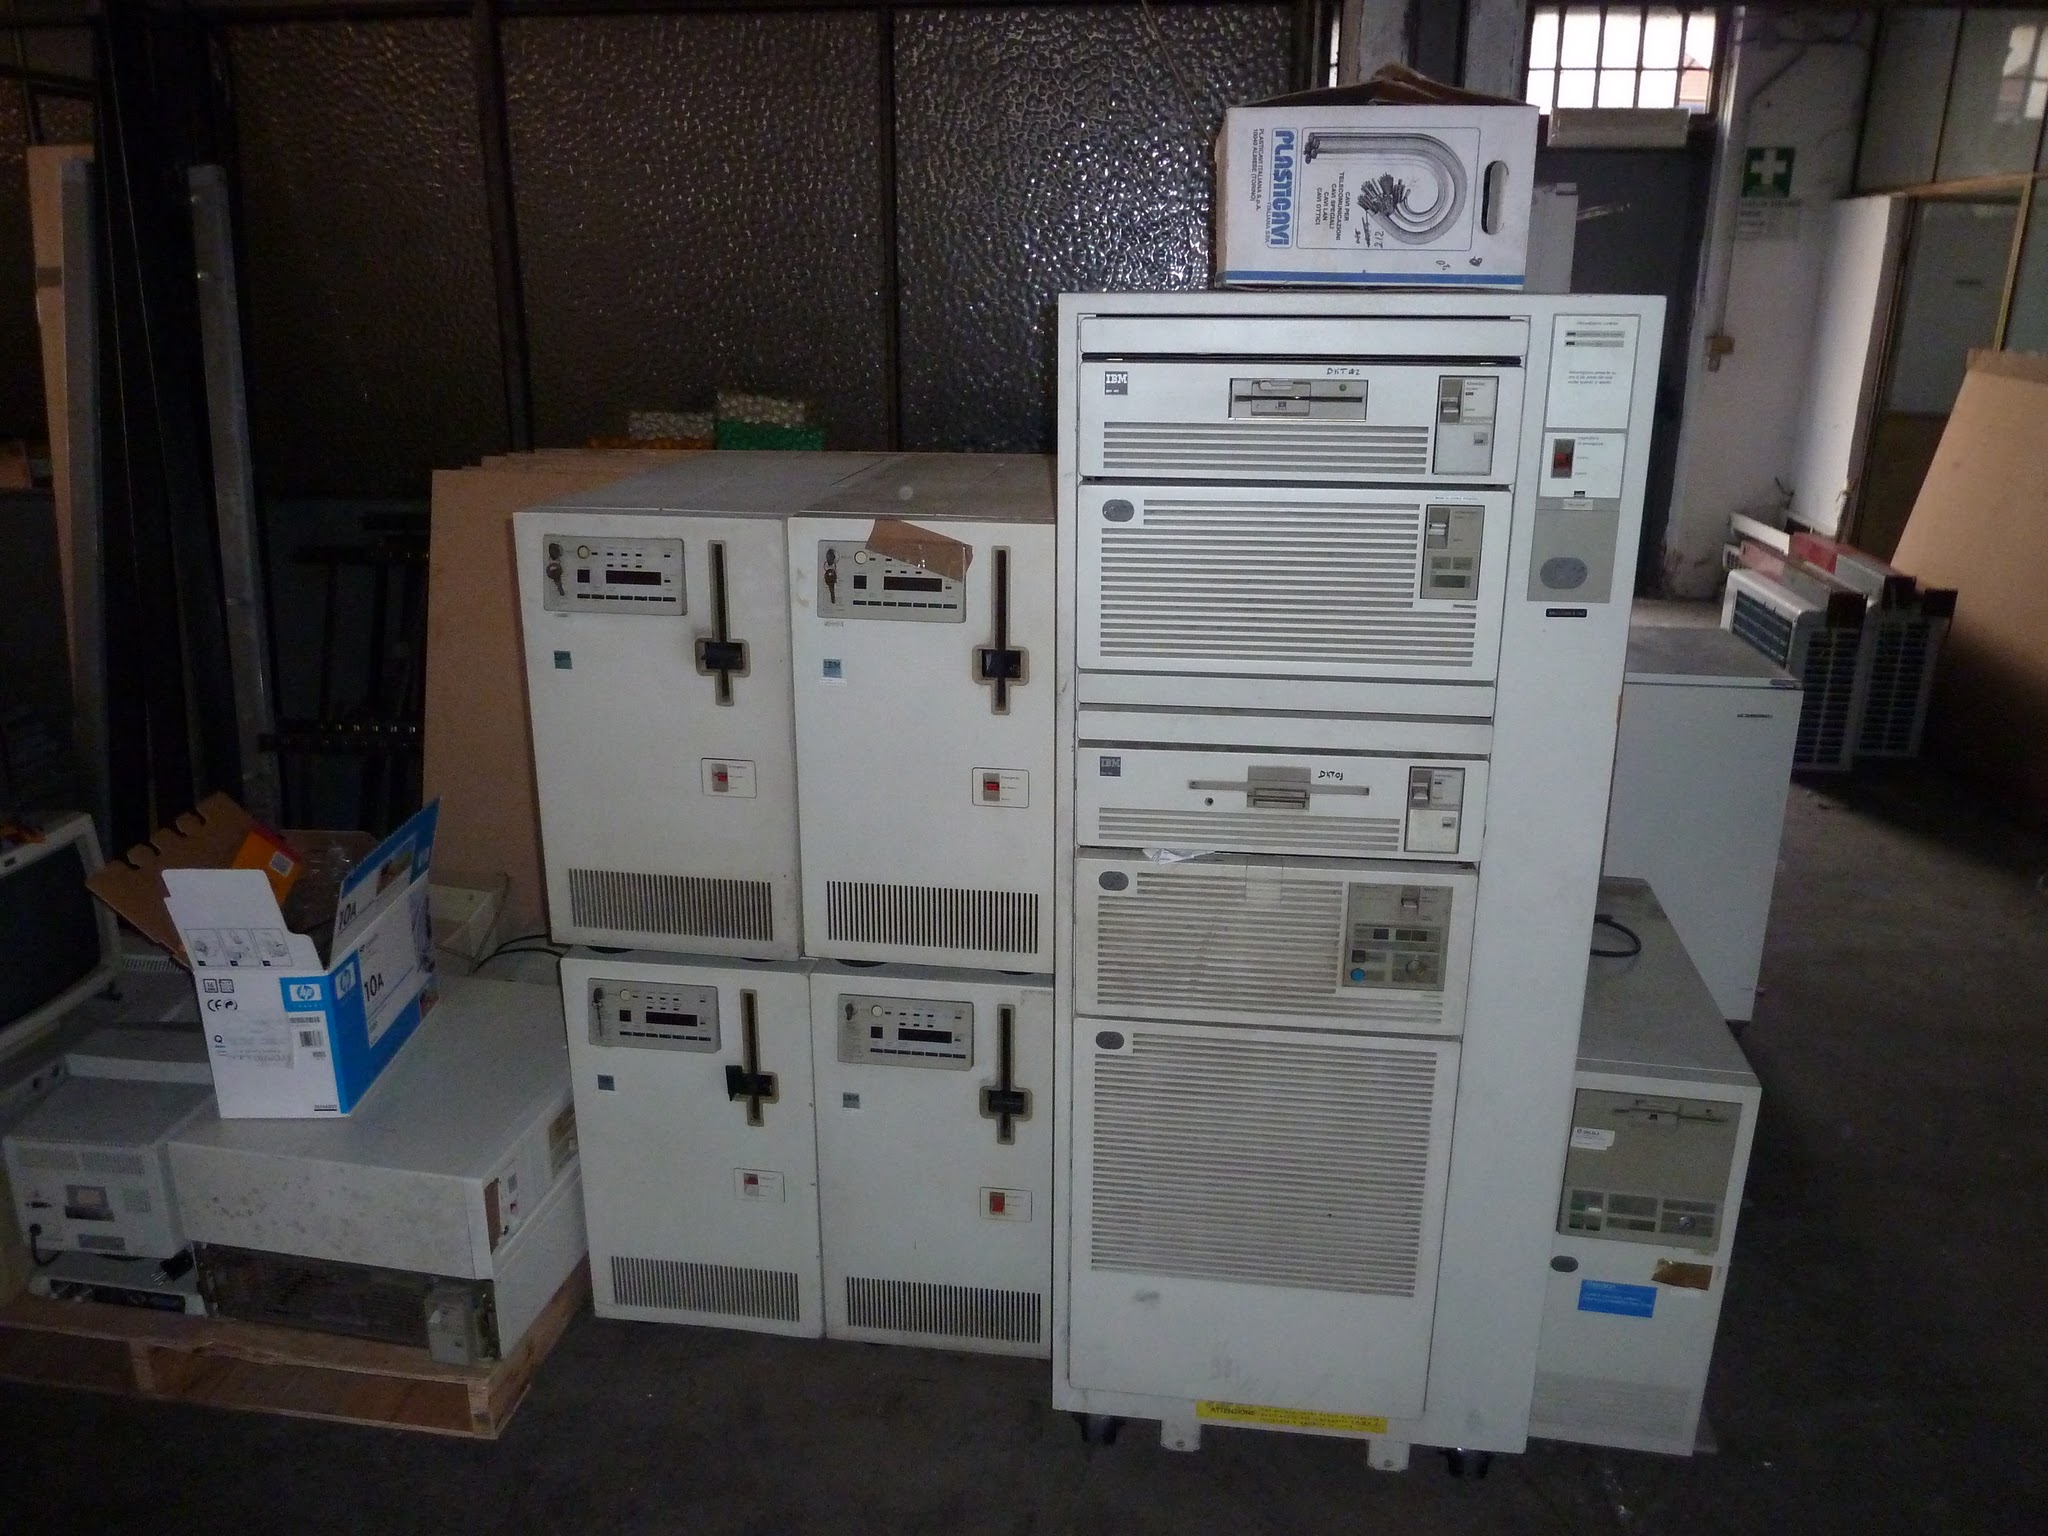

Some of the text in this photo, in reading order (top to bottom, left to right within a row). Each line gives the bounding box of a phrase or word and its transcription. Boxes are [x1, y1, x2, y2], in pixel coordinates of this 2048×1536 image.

[1336, 172, 1344, 240] TELECOMUNICAZIONI
[1374, 231, 1385, 248] 212
[1106, 374, 1128, 384] IBM
[1101, 758, 1121, 768] IBM
[364, 972, 385, 1002] 10A
